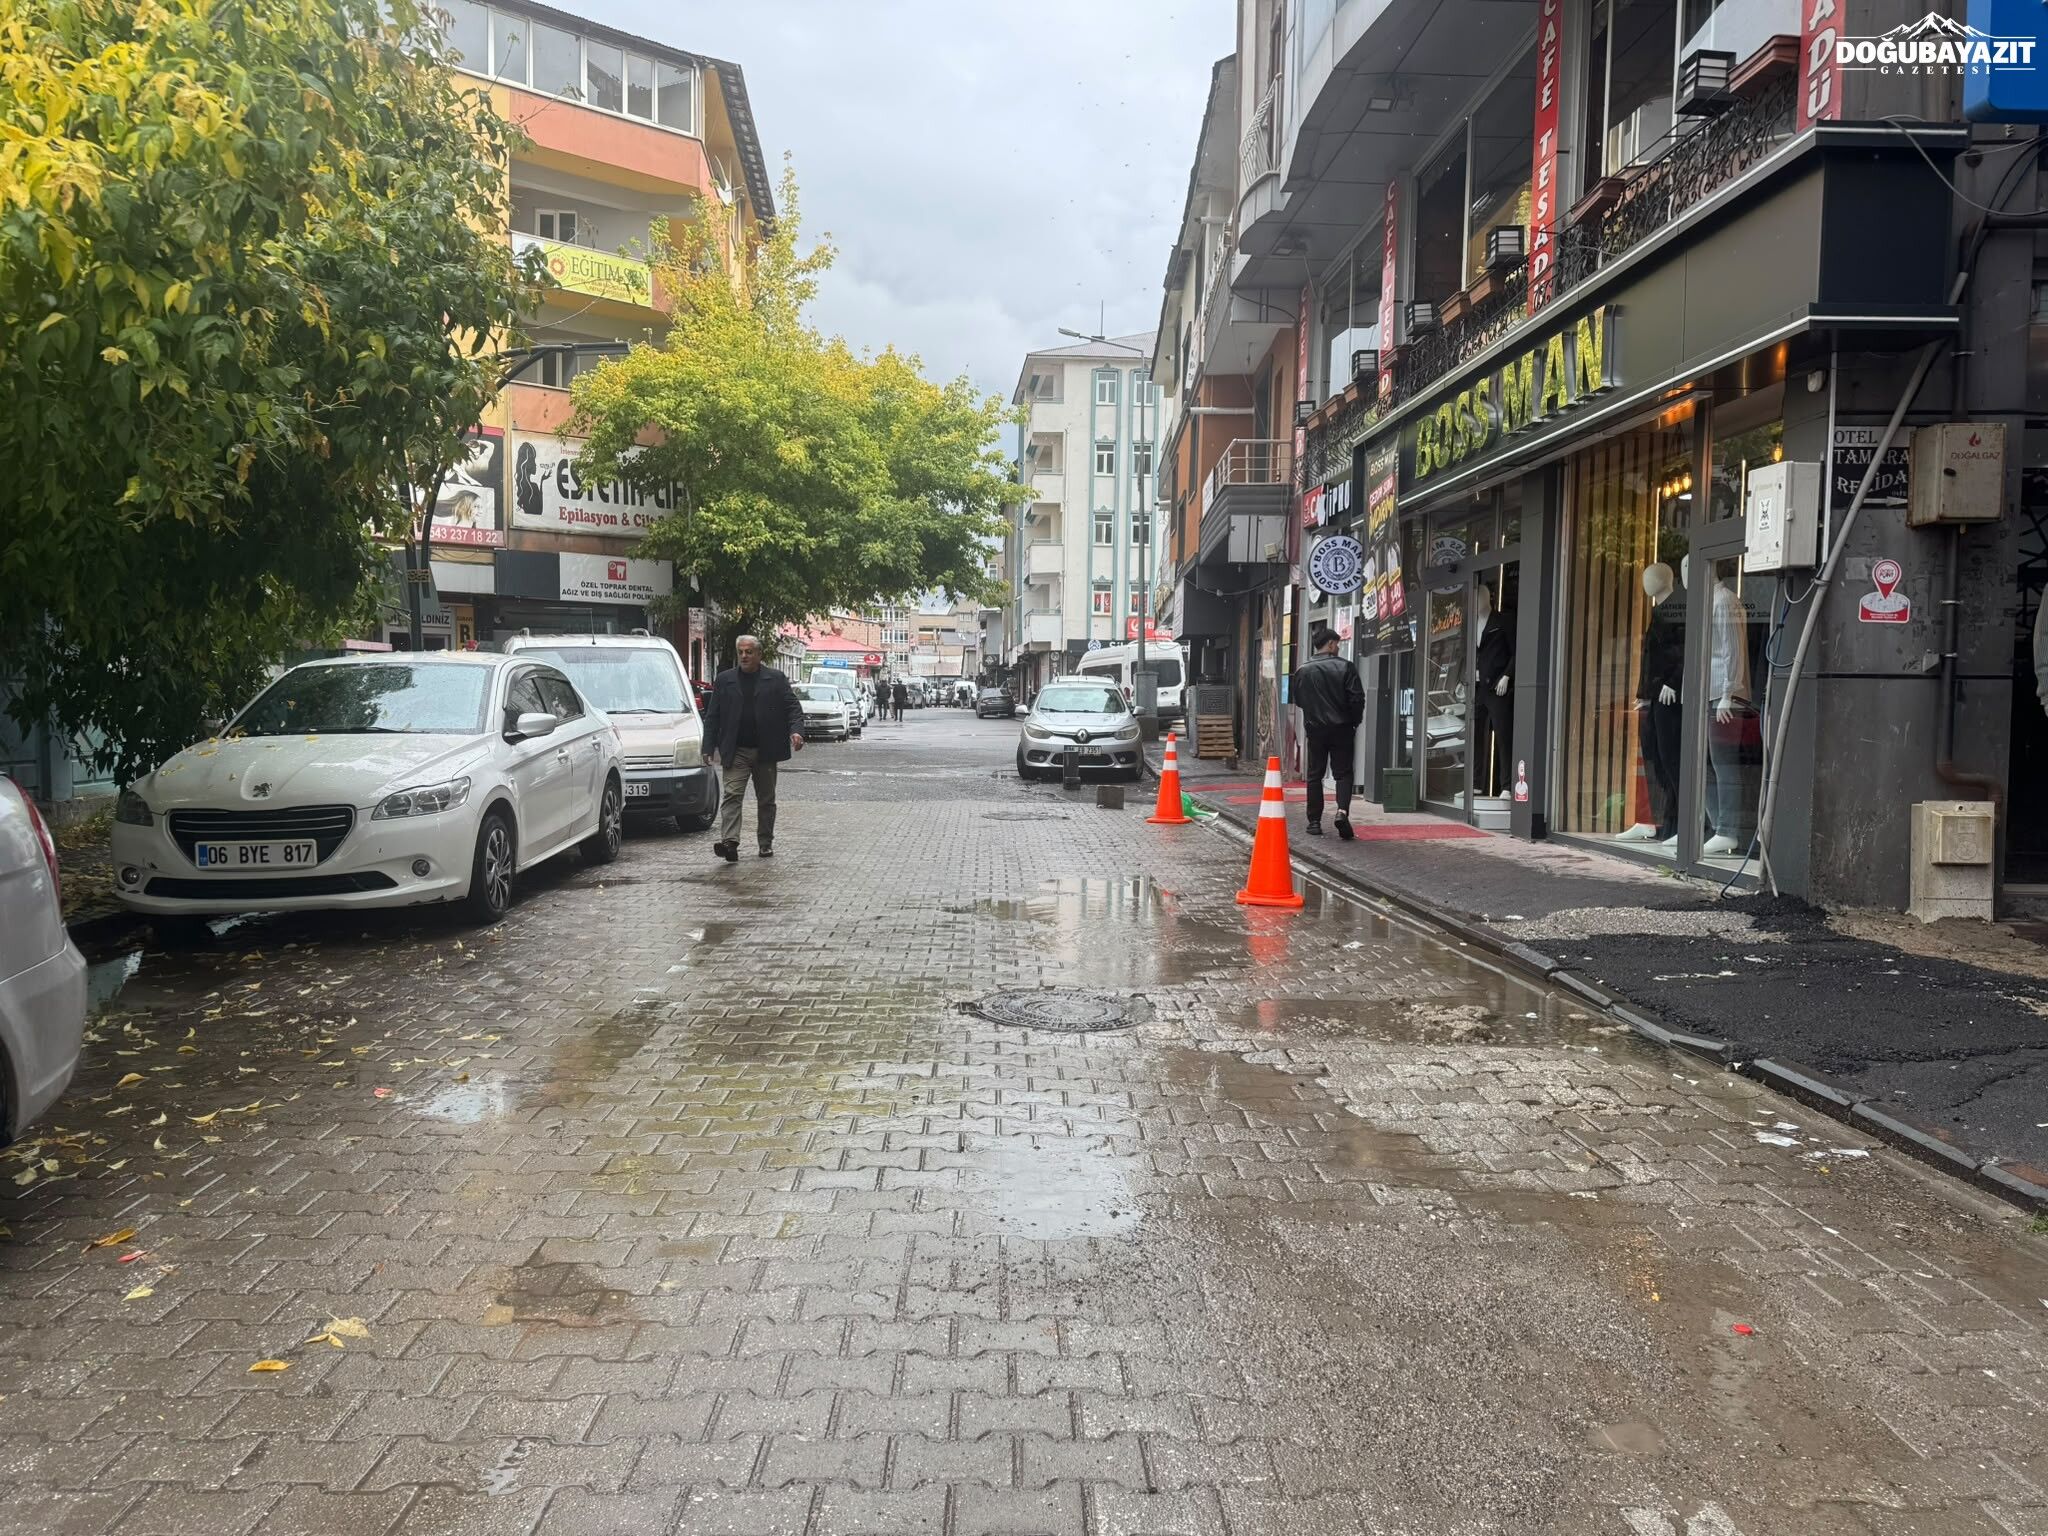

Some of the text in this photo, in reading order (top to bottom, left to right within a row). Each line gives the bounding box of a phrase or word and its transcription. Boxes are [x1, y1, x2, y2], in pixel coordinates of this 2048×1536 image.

[1415, 304, 1615, 479] BOSS MAN
[1834, 430, 1878, 444] OTEL
[1835, 449, 1910, 464] TAMRA
[559, 506, 618, 526] Epilasyon
[621, 512, 630, 526] &
[450, 529, 468, 541] 237
[471, 531, 483, 542] 18
[485, 533, 497, 544] 22
[1313, 539, 1363, 562] BOSS MAN
[1334, 556, 1346, 573] B
[581, 580, 654, 593] ÖZEL TOPRAK DENTAL
[1313, 571, 1340, 590] BOSS
[562, 588, 579, 596] AĞIZ
[580, 589, 590, 597] VE
[591, 590, 603, 598] DİŞ
[604, 591, 631, 600] SAĞLIĞI
[625, 785, 648, 795] 319
[208, 845, 312, 864] 06 BYE 817
